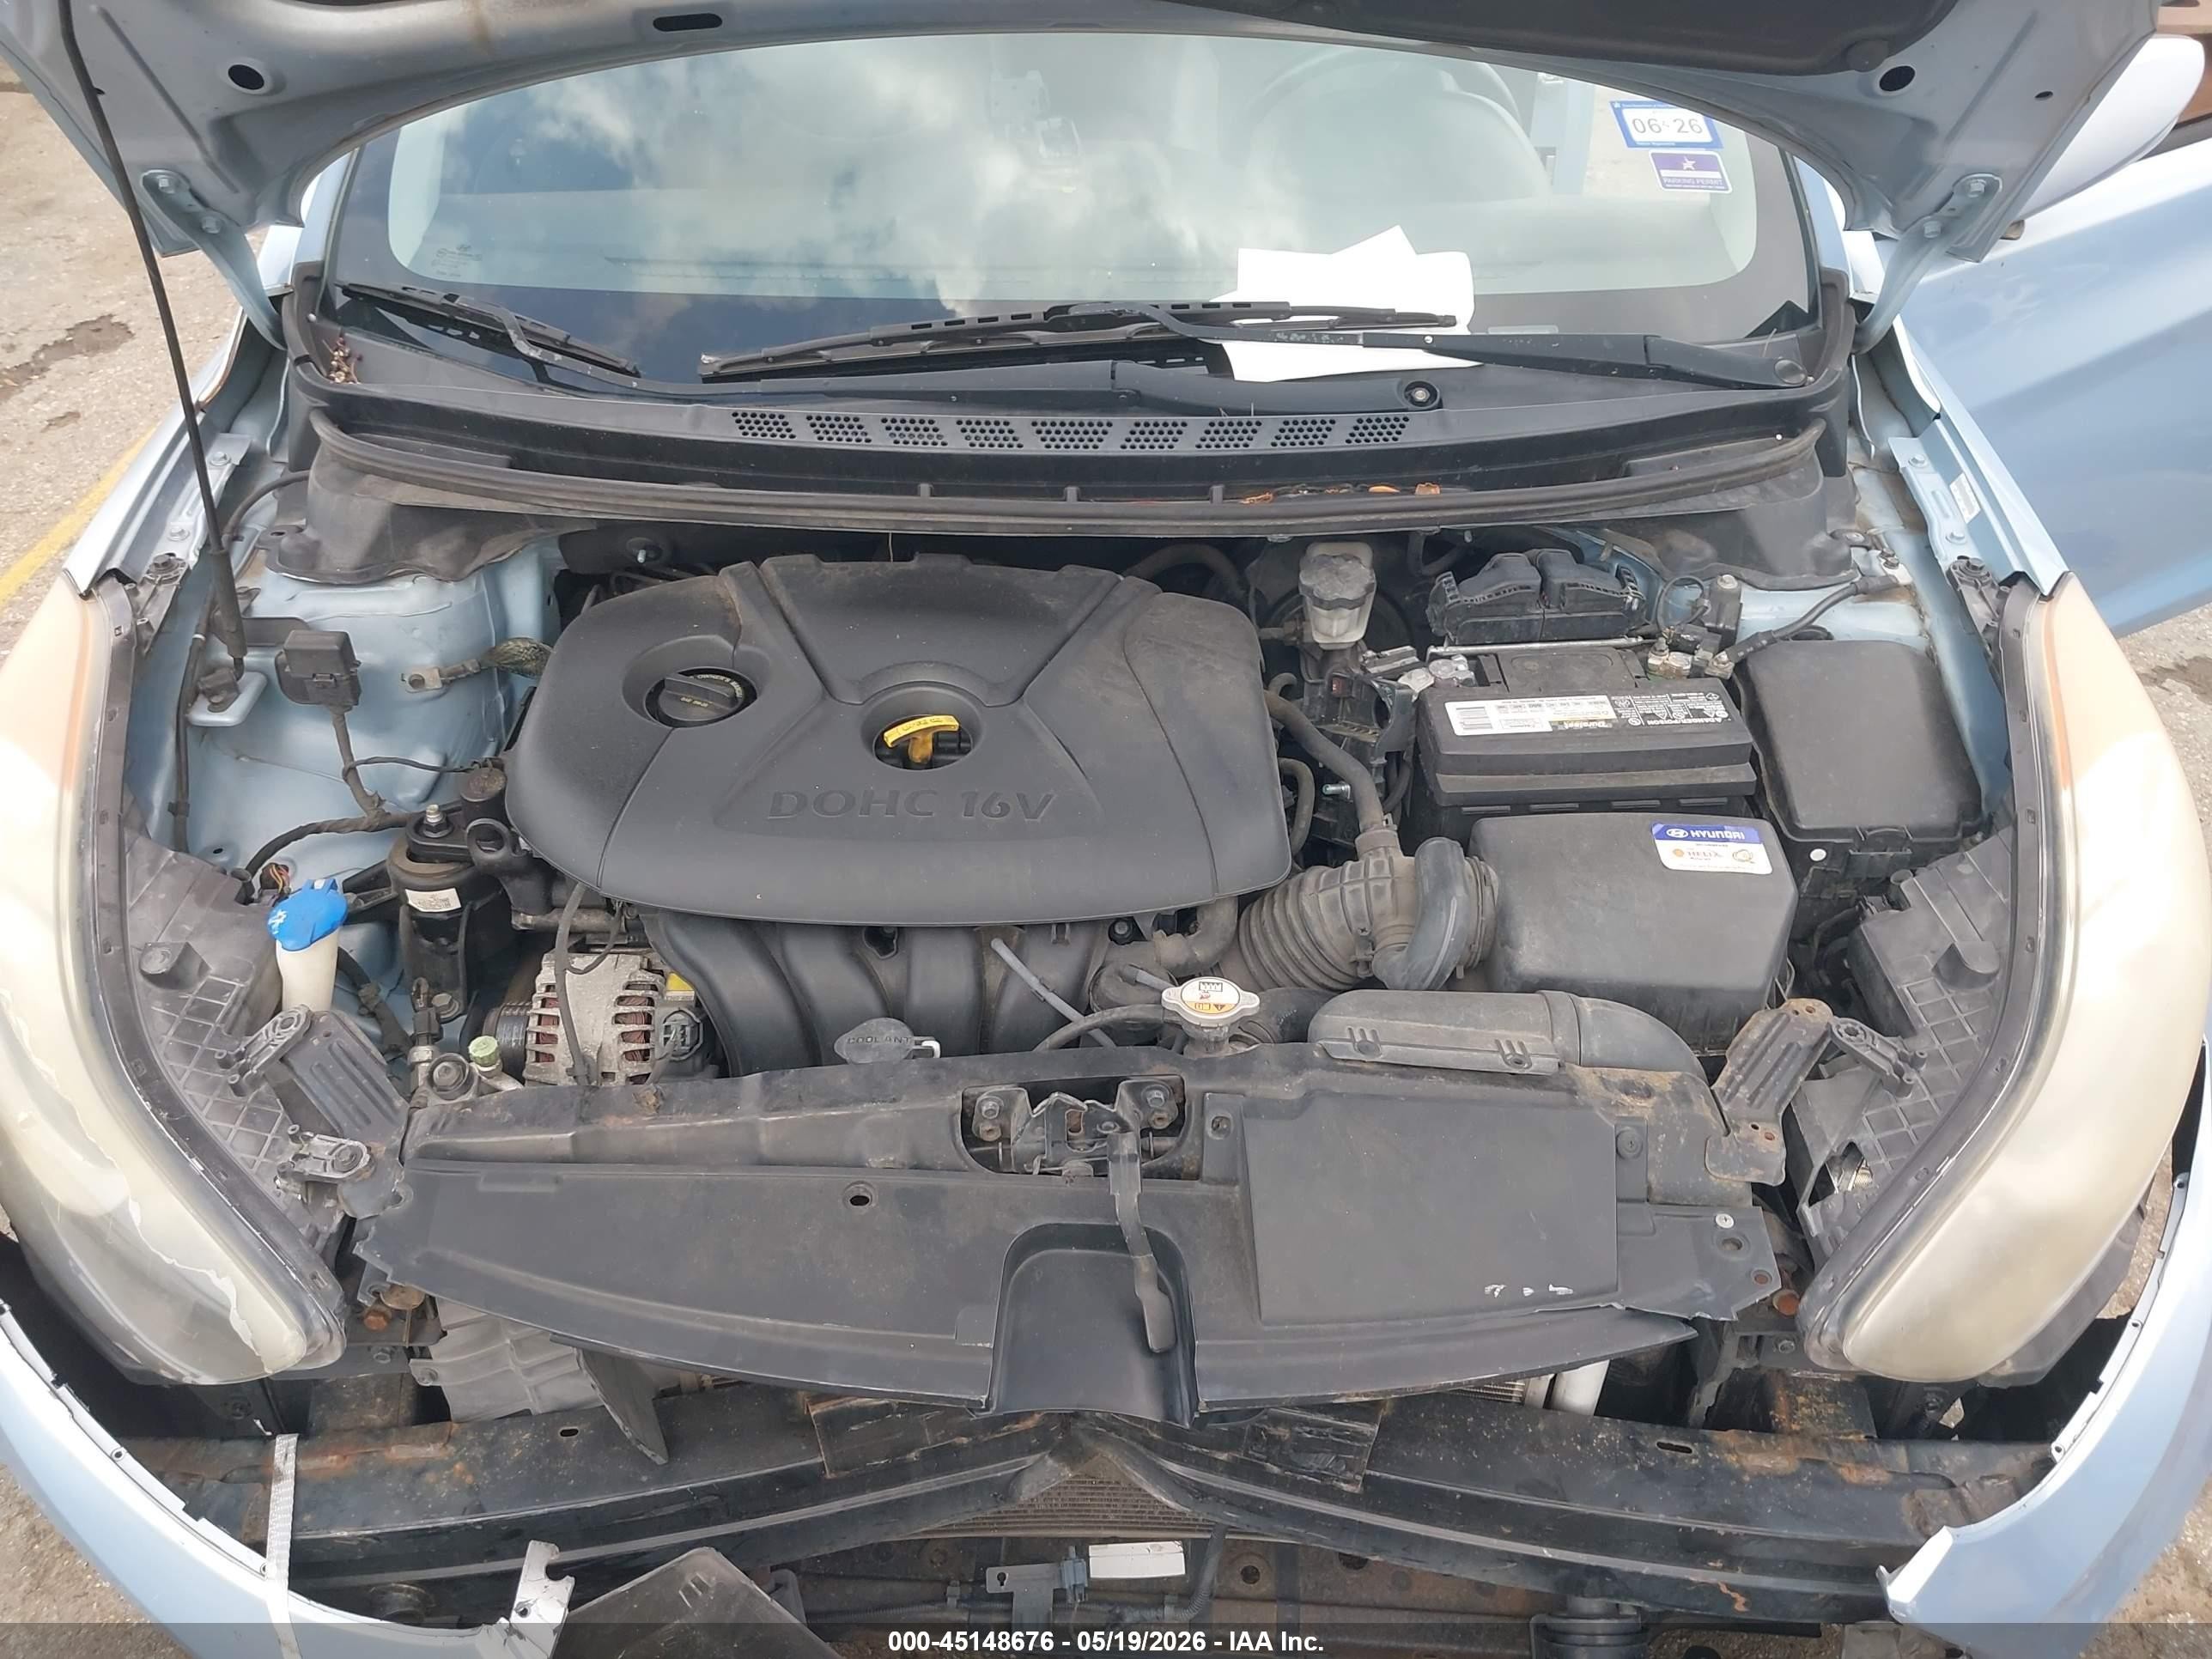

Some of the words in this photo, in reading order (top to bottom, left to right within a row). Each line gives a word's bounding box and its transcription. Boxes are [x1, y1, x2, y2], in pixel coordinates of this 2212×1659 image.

[1632, 118, 1662, 134] 06
[1673, 118, 1704, 134] 26
[768, 788, 939, 819] DOHC
[960, 790, 1054, 821] 16V
[1689, 830, 1746, 840] HYUNDAI
[847, 1036, 911, 1045] COOLANT
